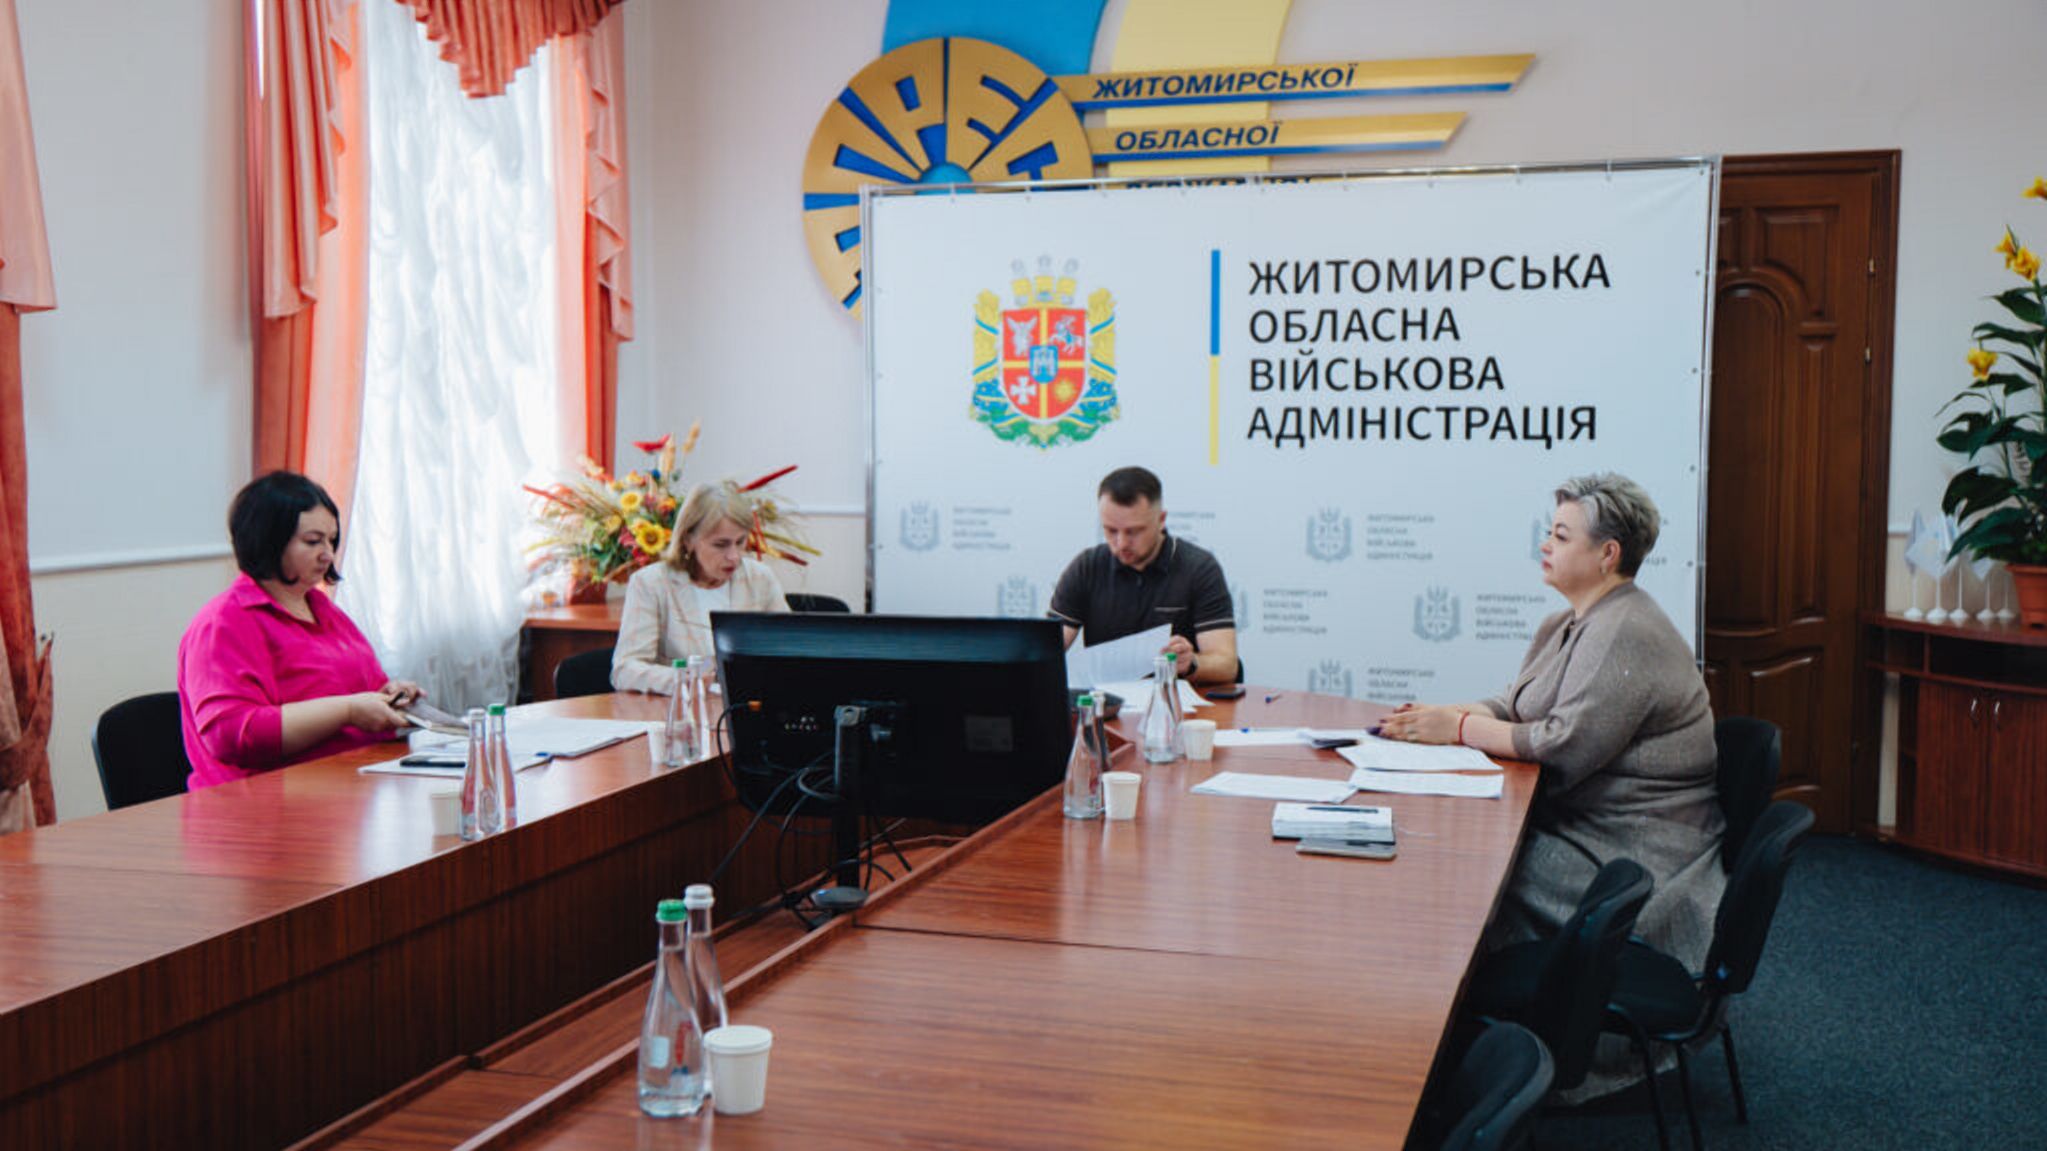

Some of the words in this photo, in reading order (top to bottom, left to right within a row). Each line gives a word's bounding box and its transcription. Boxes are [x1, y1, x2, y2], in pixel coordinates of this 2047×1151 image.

[1092, 63, 1359, 99] ЖИТОМИРСЬКОЇ
[1114, 121, 1284, 151] ОБЛАСНОЇ
[1248, 253, 1612, 295] ЖИТОМИРСЬКА
[1249, 307, 1461, 343] ОБЛАСНА
[1250, 348, 1505, 392] ВІЙСЬКОВА
[1247, 405, 1598, 450] АДМІНІСТРАЦІЯ
